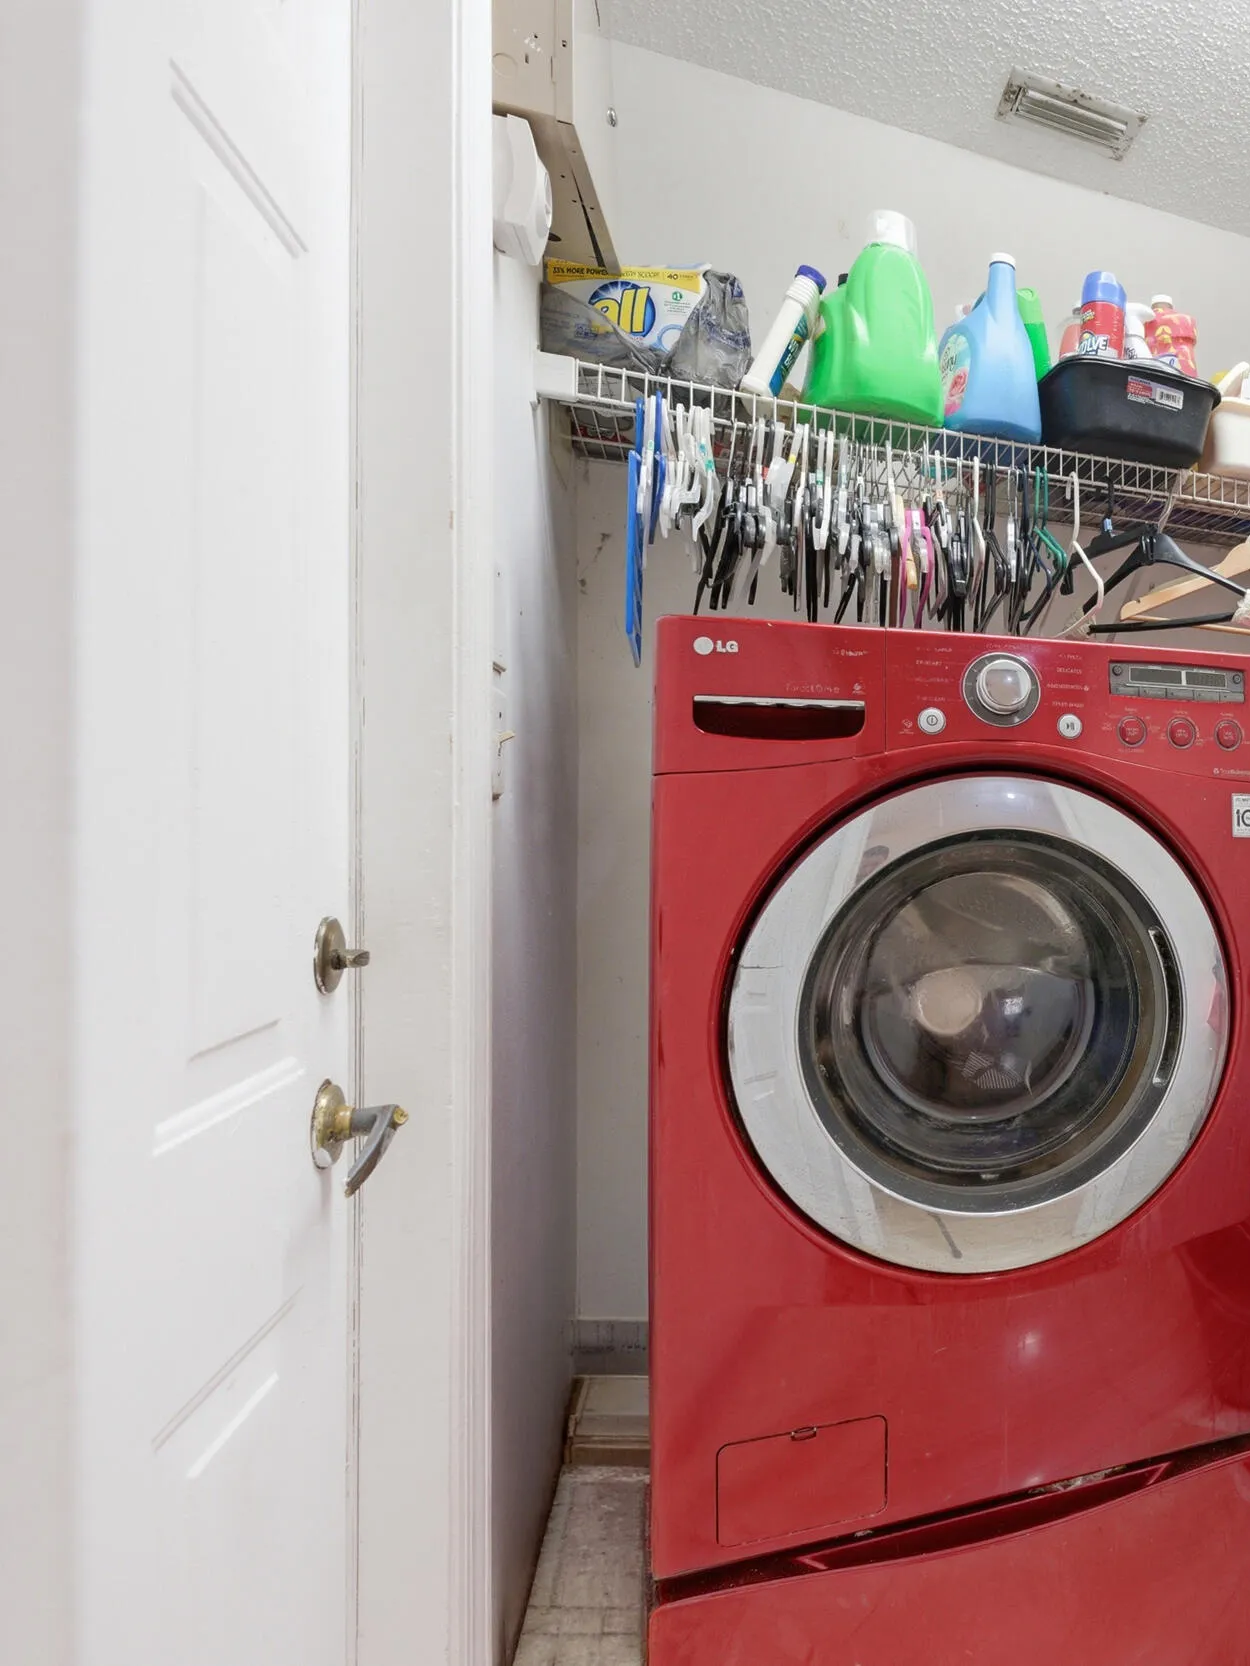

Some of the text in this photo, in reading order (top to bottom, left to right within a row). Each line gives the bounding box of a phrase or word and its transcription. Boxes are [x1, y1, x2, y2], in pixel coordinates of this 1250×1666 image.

[566, 267, 585, 275] MORE
[591, 286, 651, 334] all
[716, 640, 739, 653] LG
